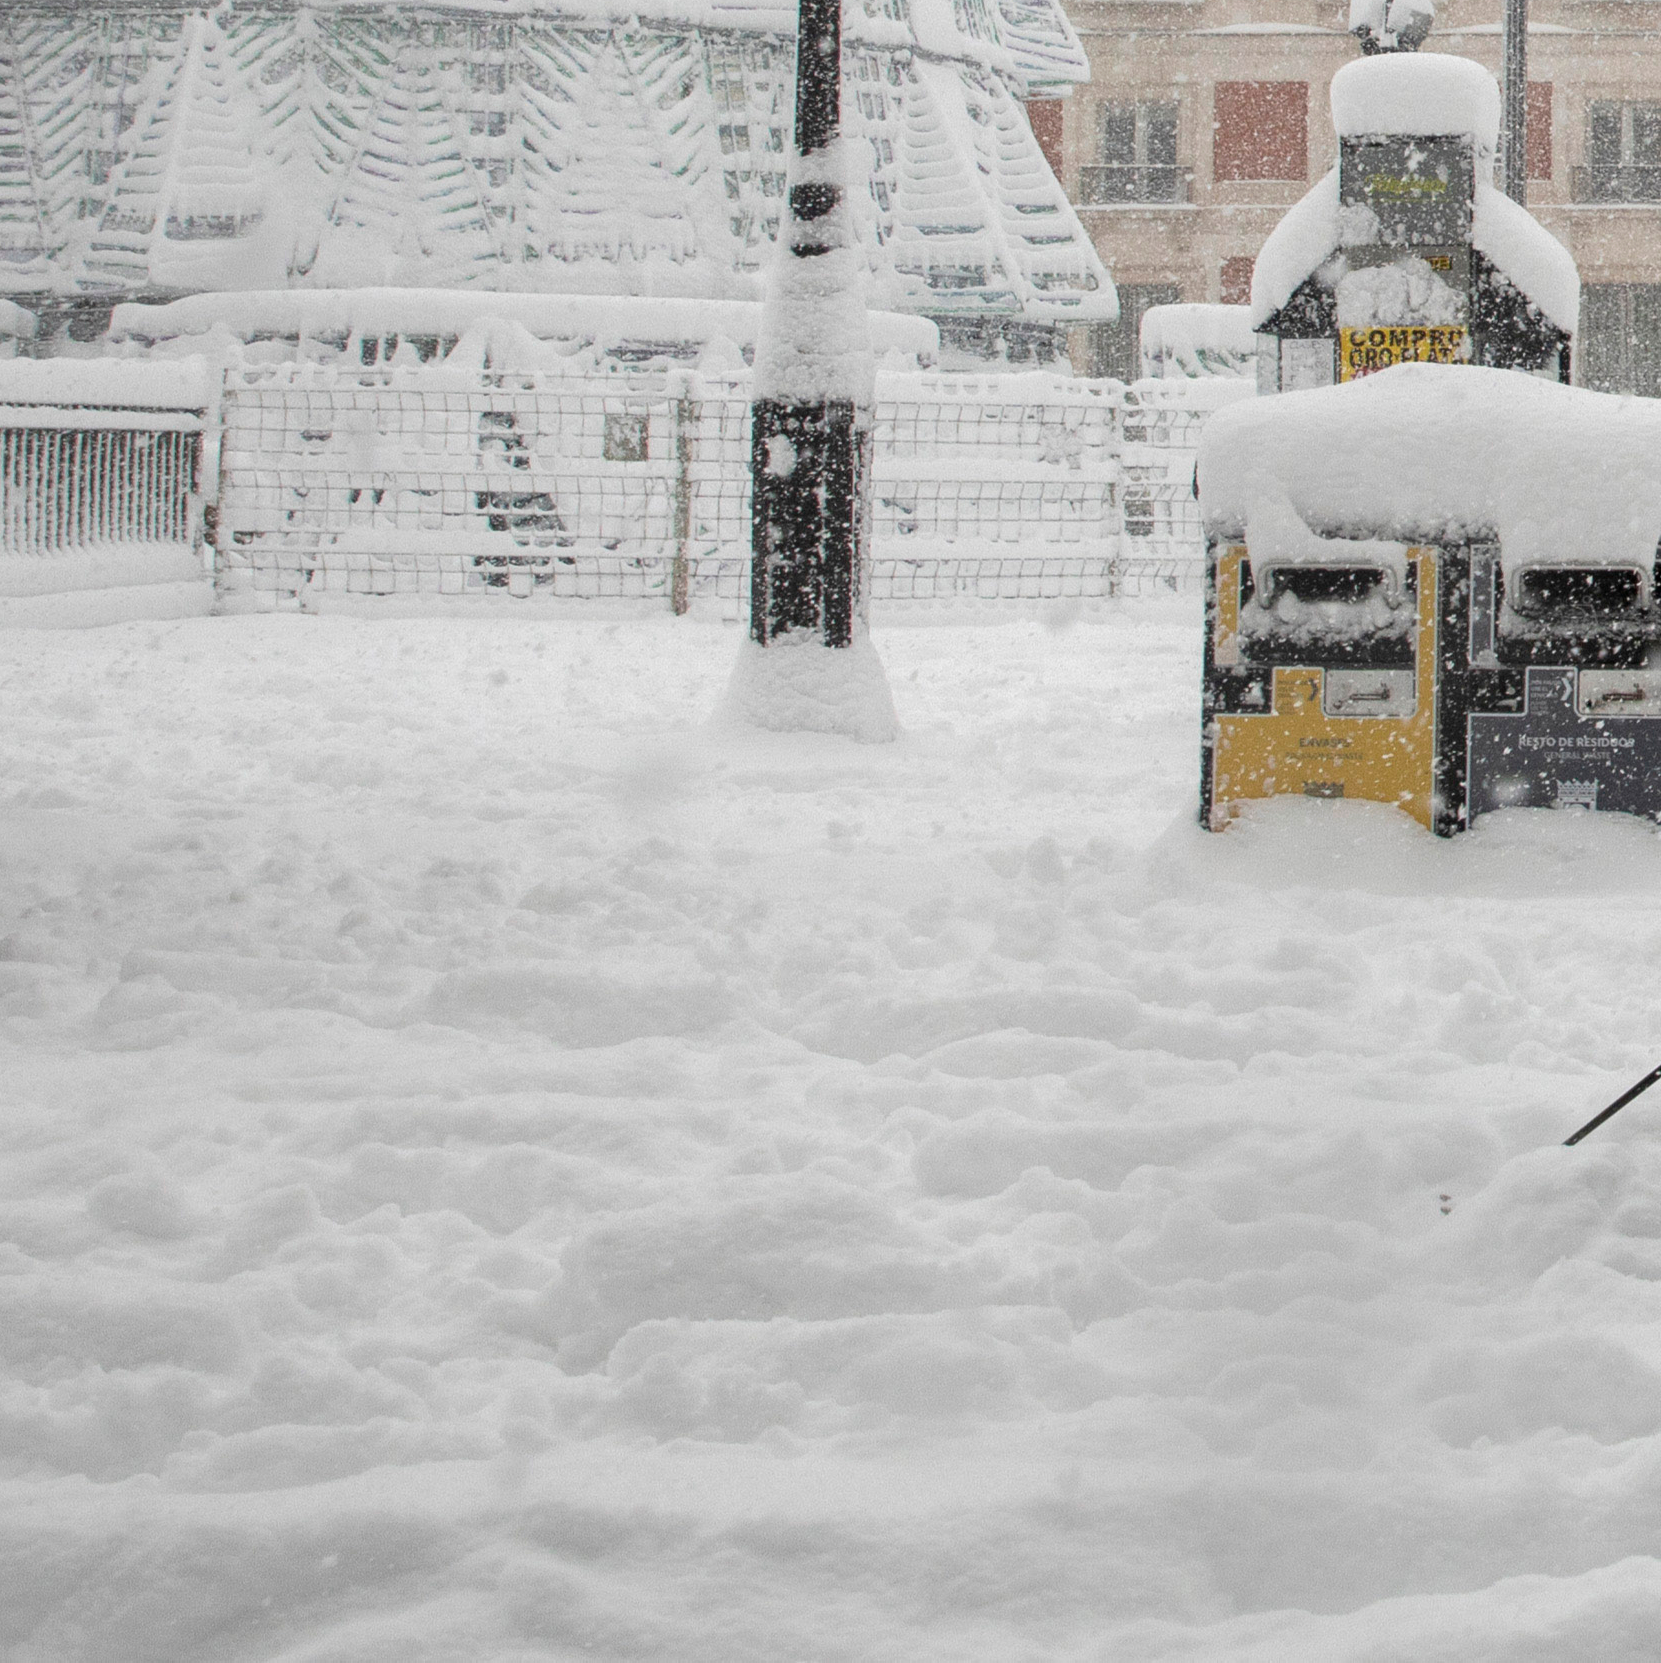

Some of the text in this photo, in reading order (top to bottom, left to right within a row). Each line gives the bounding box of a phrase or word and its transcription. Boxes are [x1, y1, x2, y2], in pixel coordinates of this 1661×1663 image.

[1299, 738, 1351, 748] ENVASES
[1519, 737, 1635, 748] RESTO DE RESIDUOS
[1544, 751, 1611, 760] GENERAL WASTE
